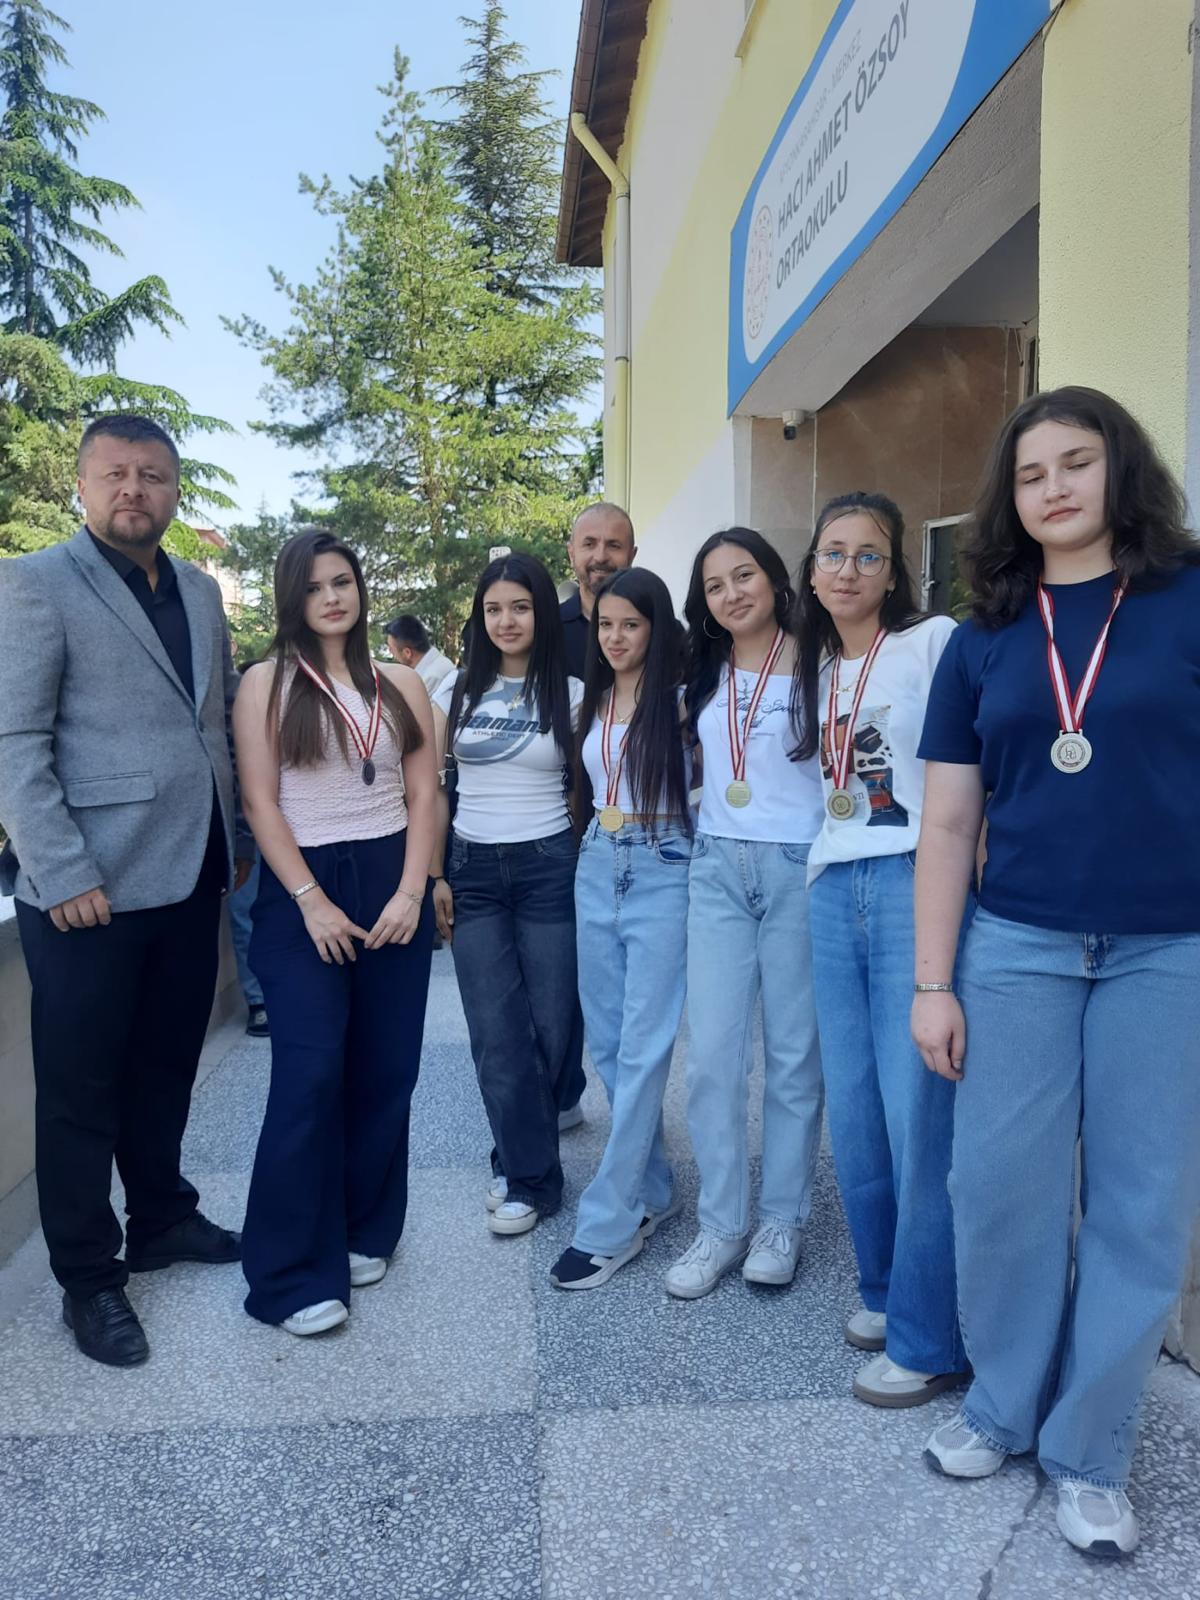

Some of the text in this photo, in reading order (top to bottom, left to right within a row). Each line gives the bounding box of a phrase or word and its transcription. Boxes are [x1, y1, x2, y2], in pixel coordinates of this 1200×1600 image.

[777, 171, 804, 238] HACI
[806, 90, 851, 196] AHMET
[855, 0, 909, 114] ÖZSOY
[776, 160, 848, 289] ORTAOKULU
